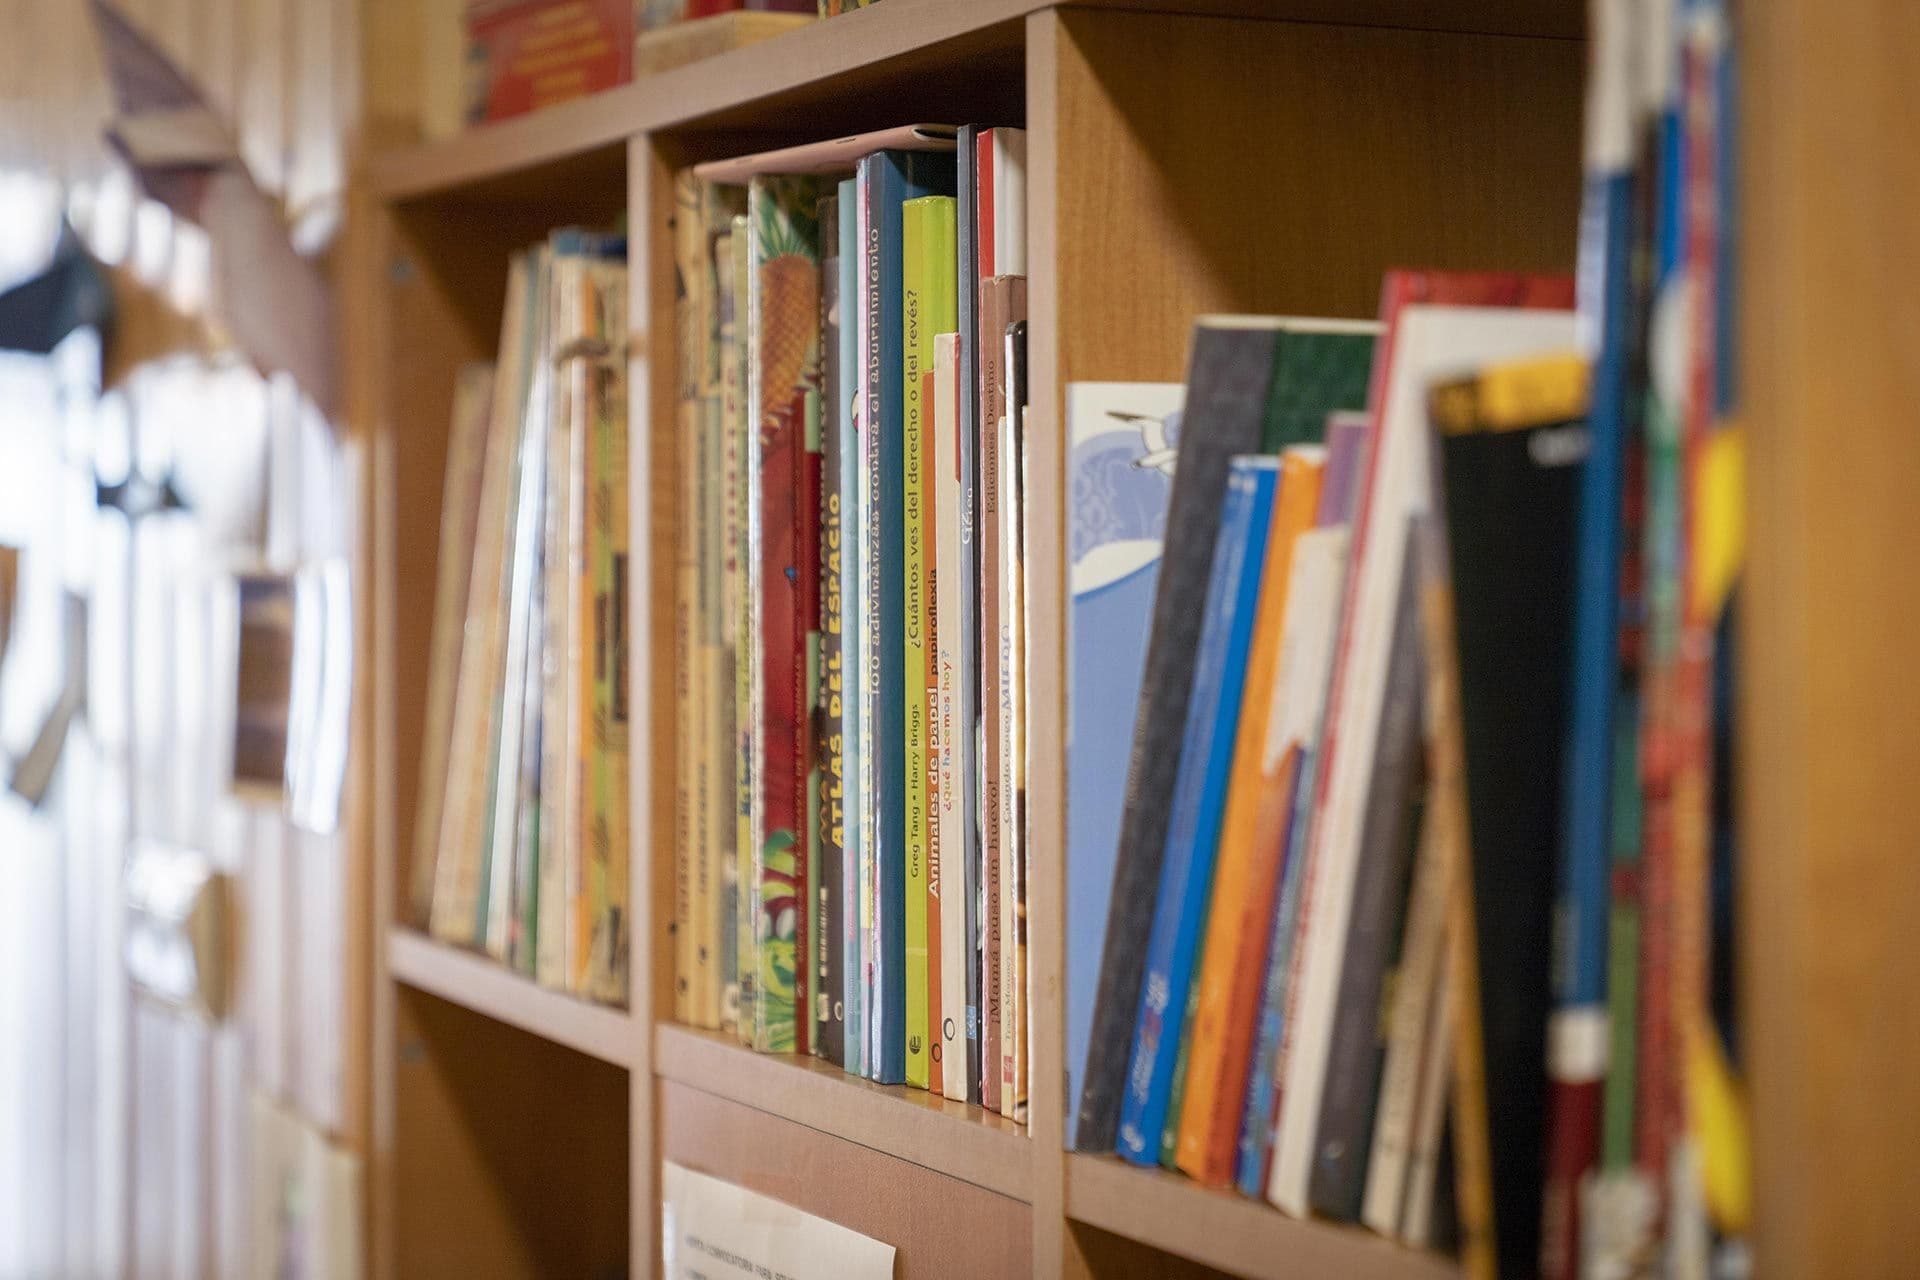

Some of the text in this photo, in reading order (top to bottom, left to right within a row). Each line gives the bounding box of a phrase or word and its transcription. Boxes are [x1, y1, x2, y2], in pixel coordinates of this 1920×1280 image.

[867, 228, 880, 384] aburrimiento
[868, 393, 880, 413] el
[868, 421, 881, 502] contra
[906, 290, 922, 649] ¿Cuántos ves del derecho o del revés?
[985, 360, 996, 514] Ediciones Destino
[869, 511, 881, 647] adivinanzas
[829, 651, 842, 718] DEL
[926, 568, 940, 900] Animales de papel papiroflexia
[940, 696, 952, 767] hacemos
[829, 734, 844, 849] ATLAS
[909, 704, 921, 879] Greg Tang Harry Briggs
[941, 771, 953, 812] ¿Qué
[987, 780, 1001, 1024] ¡Mamá puso un huevo!
